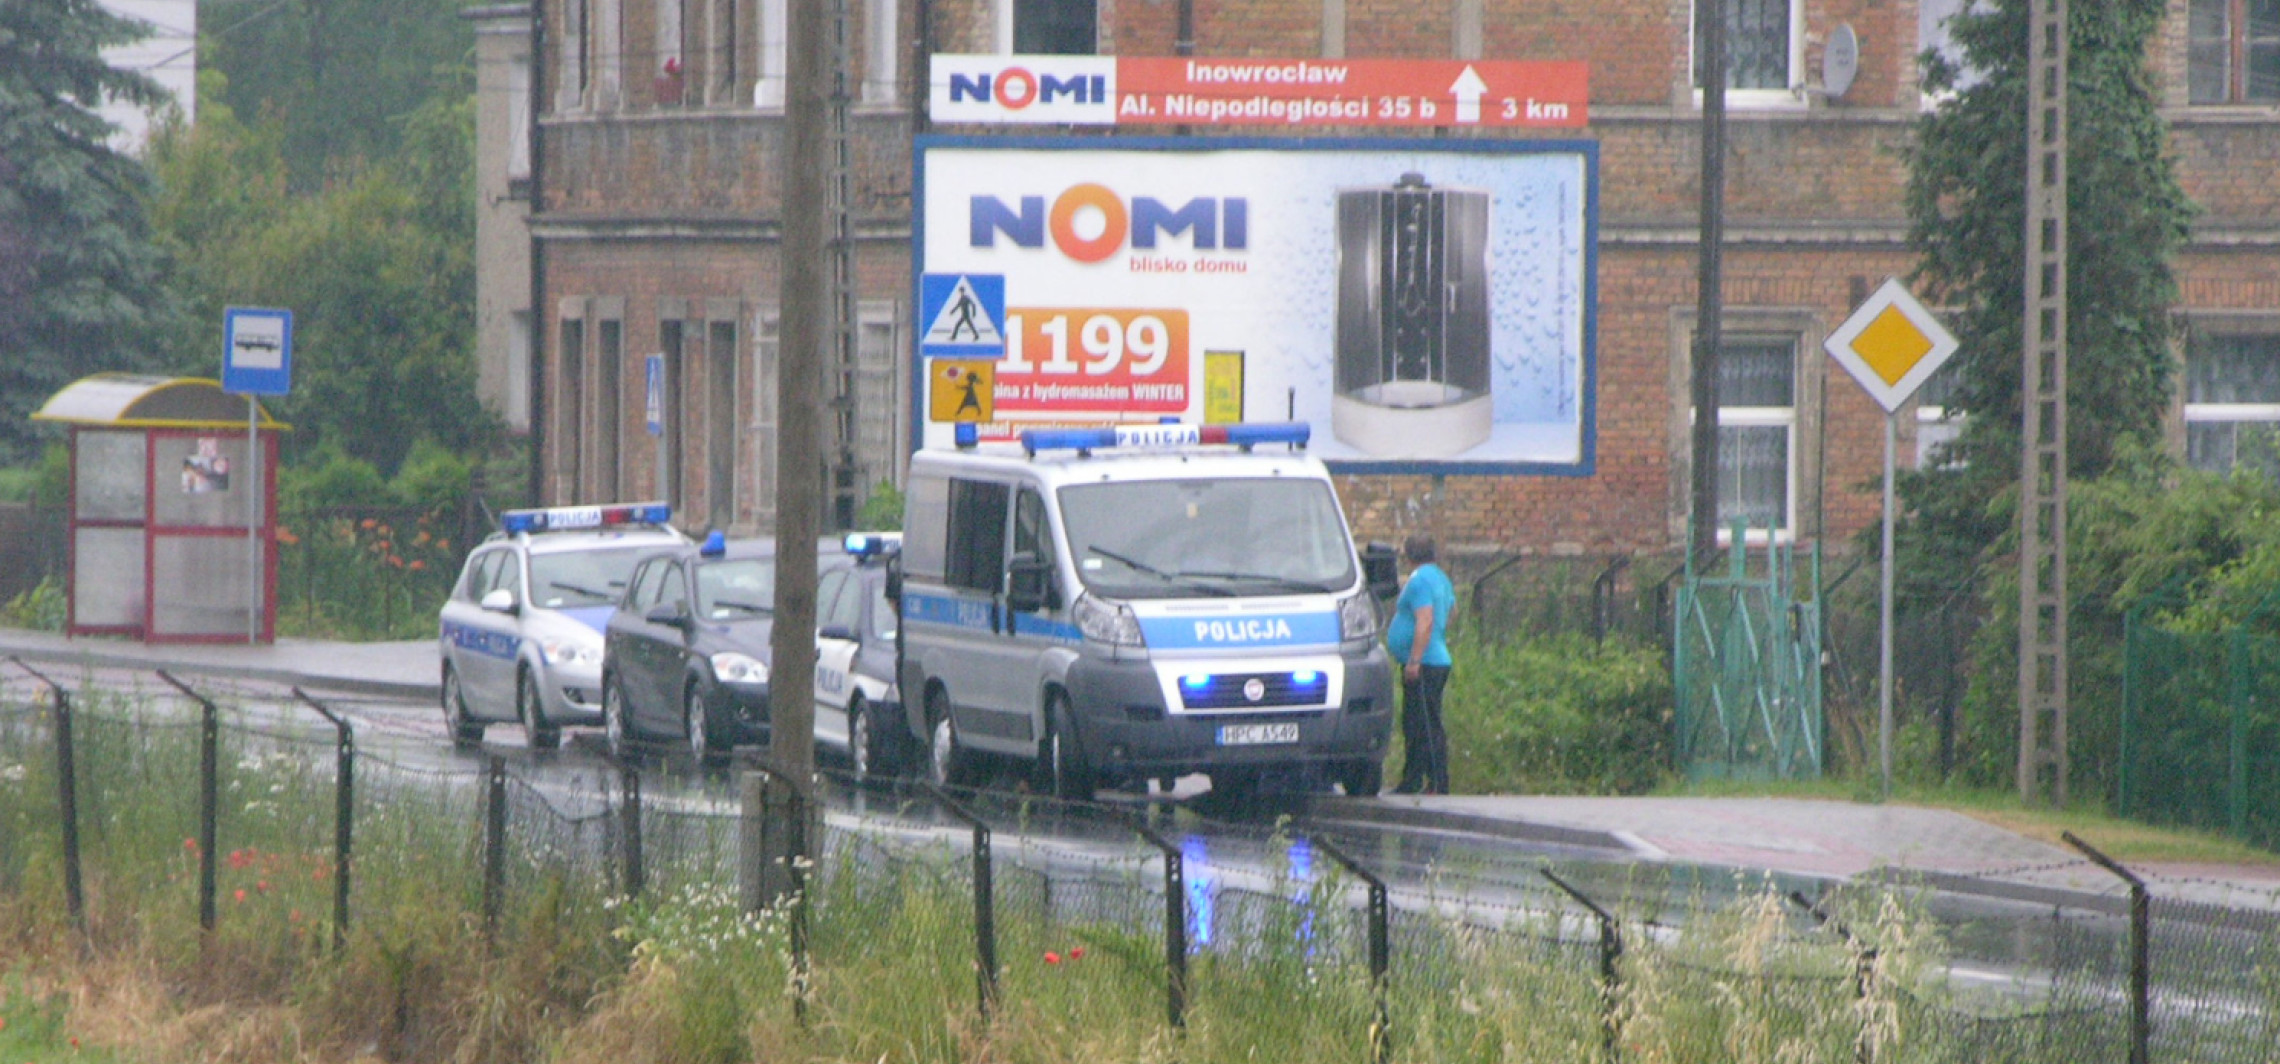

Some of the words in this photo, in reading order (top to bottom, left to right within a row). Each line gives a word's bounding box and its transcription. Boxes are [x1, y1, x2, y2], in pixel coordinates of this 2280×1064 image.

[1186, 60, 1348, 84] Inowrocław
[950, 66, 1106, 111] NOMI
[1119, 95, 1155, 116] Al.
[1165, 94, 1369, 122] Niepodległości
[1378, 96, 1412, 118] 35
[1419, 96, 1437, 118] b
[1501, 98, 1518, 119] 3
[1526, 98, 1569, 119] km
[970, 182, 1248, 263] NOMI
[1130, 256, 1188, 273] blisko
[1194, 257, 1248, 273] domu
[996, 315, 1168, 375] 1199
[1022, 385, 1031, 399] z
[1032, 382, 1129, 403] hydromasażem
[1132, 384, 1184, 400] WINTER
[1117, 430, 1198, 445] POLICJA
[550, 511, 599, 526] POLICJA
[1194, 619, 1291, 641] POLICJA
